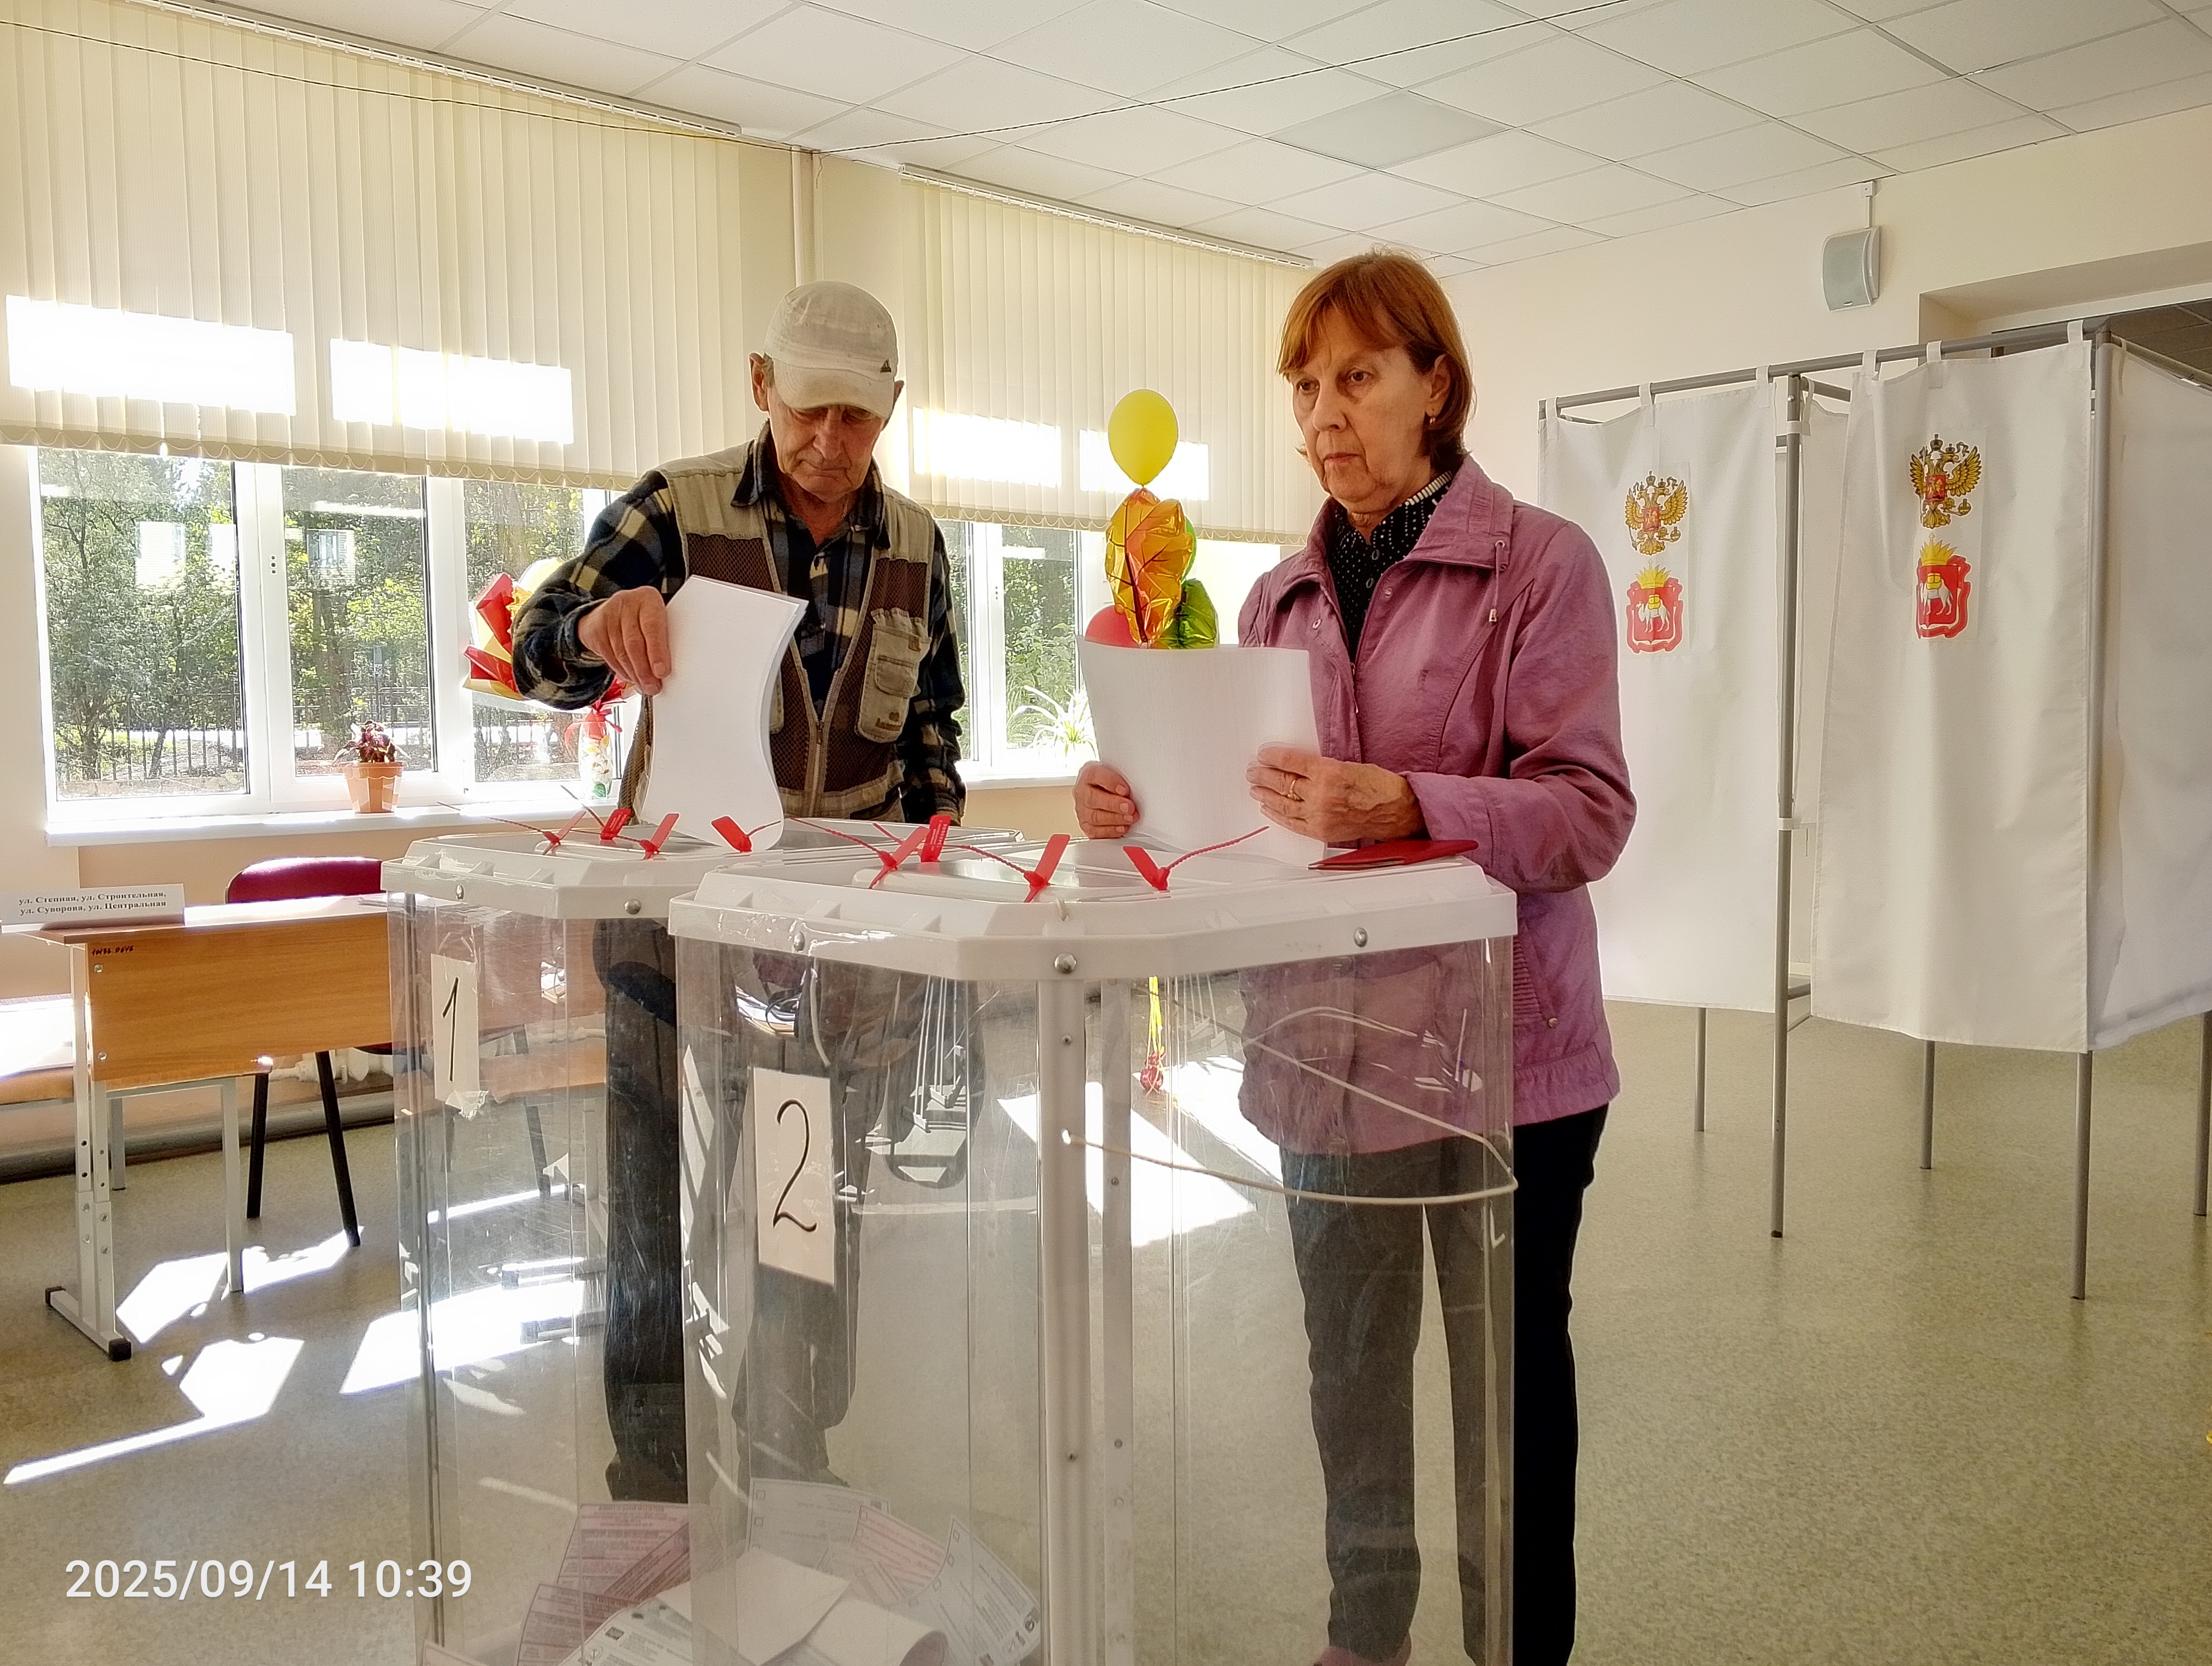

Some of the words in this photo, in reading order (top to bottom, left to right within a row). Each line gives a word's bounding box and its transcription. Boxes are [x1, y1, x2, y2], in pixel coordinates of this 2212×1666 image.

[37, 906, 86, 914] Суворова,
[105, 901, 166, 910] Центральная
[98, 892, 166, 901] Строительная,
[442, 977, 459, 1082] 1
[773, 1100, 817, 1232] 2
